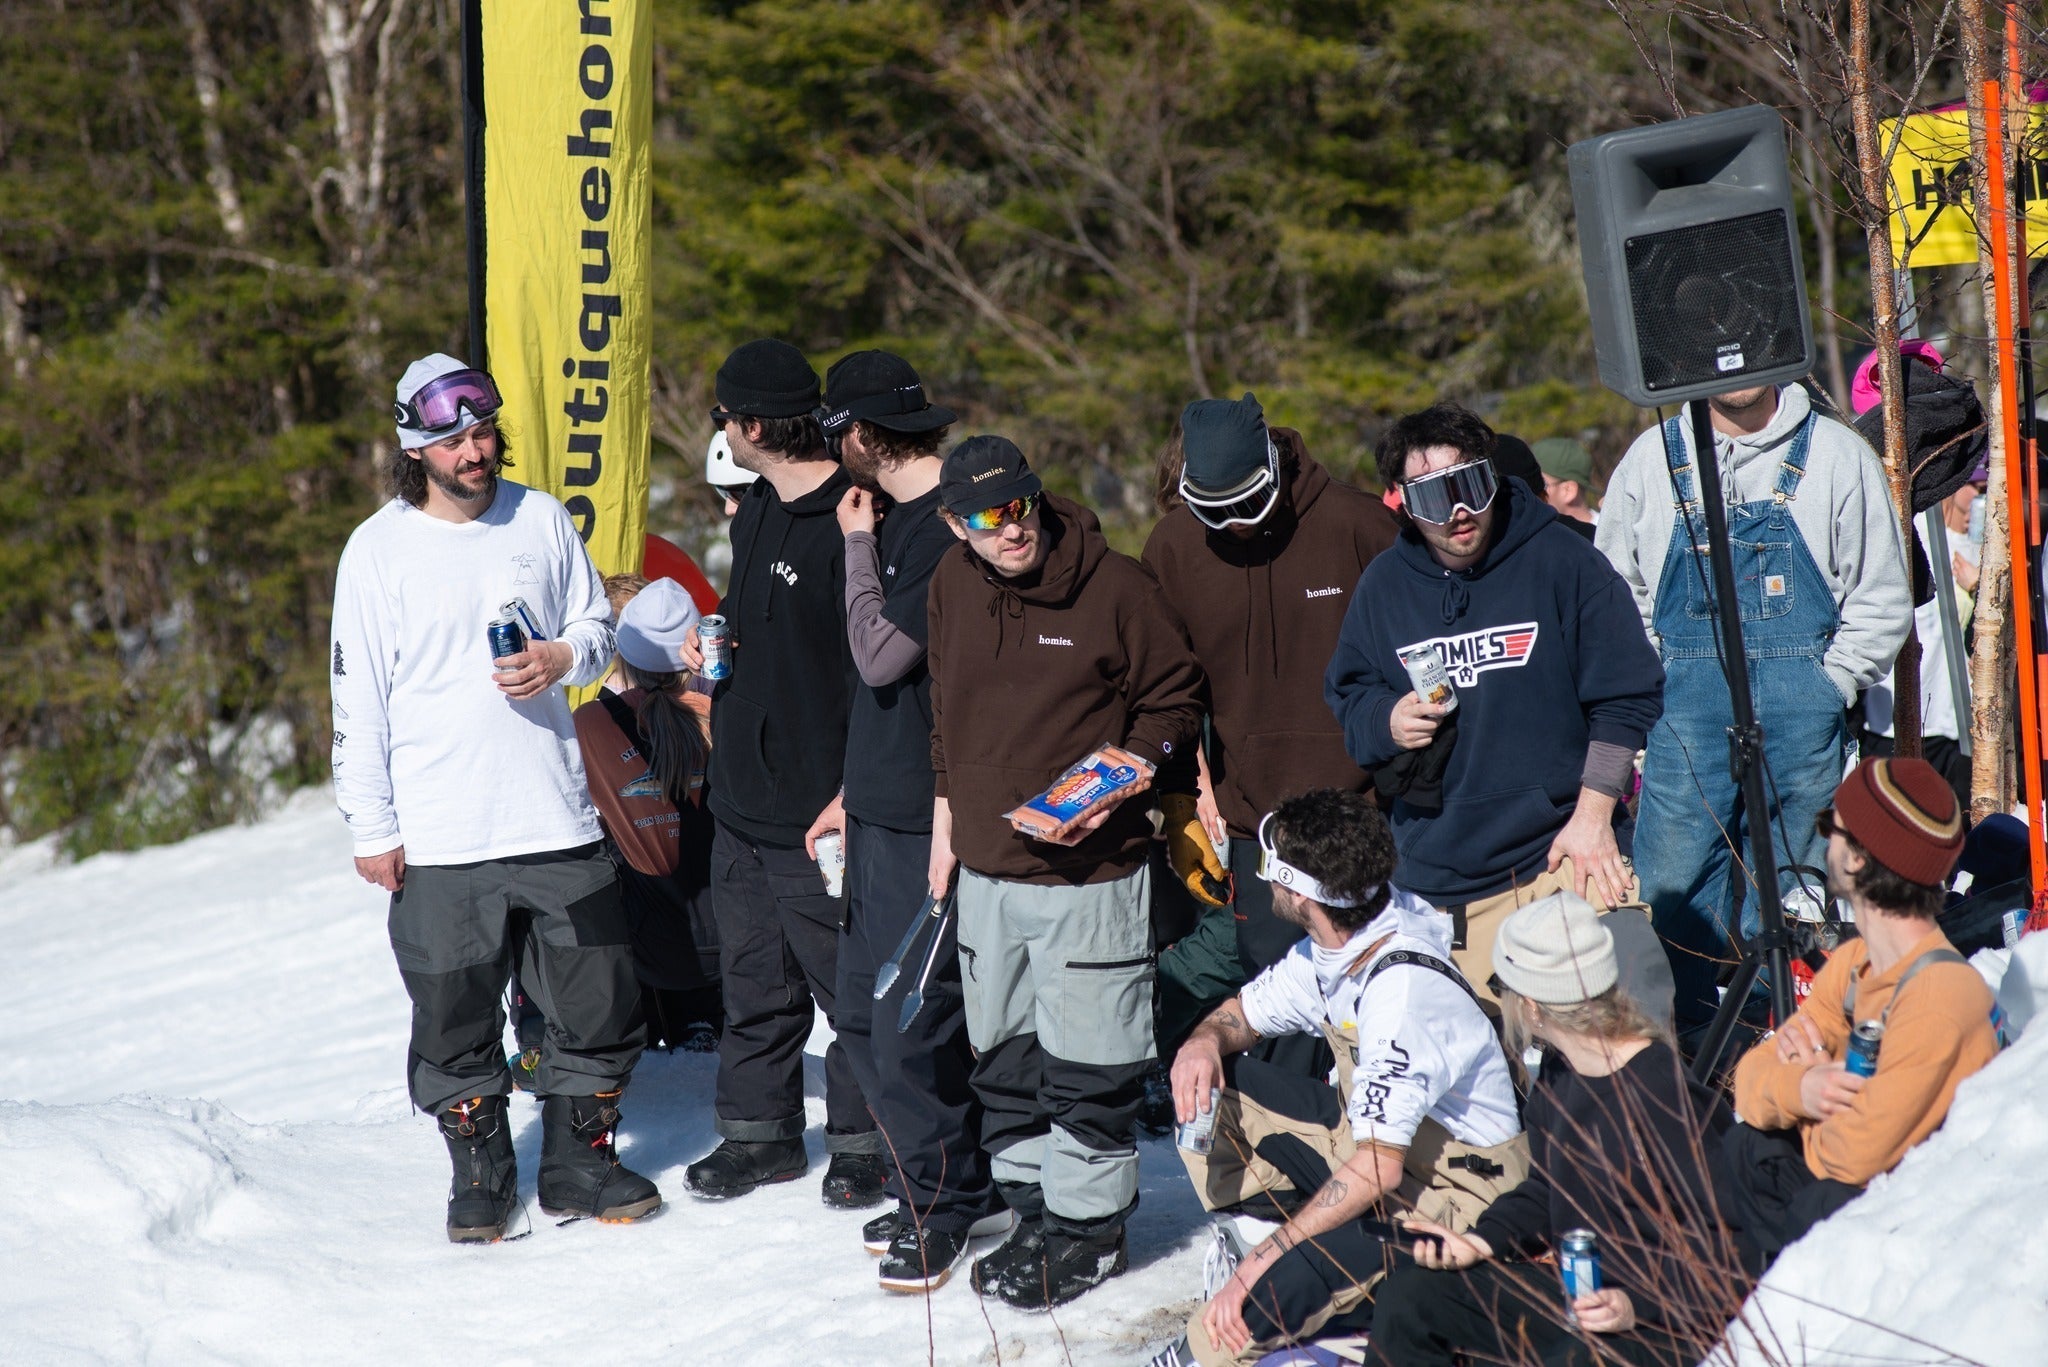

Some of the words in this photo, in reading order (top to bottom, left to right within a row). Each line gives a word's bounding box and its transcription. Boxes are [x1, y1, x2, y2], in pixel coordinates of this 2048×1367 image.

[823, 409, 851, 427] ELECTRIC
[972, 467, 1006, 483] homies.
[1306, 586, 1343, 599] homies.
[1038, 635, 1074, 646] homies.
[1428, 632, 1506, 666] OMIE'S
